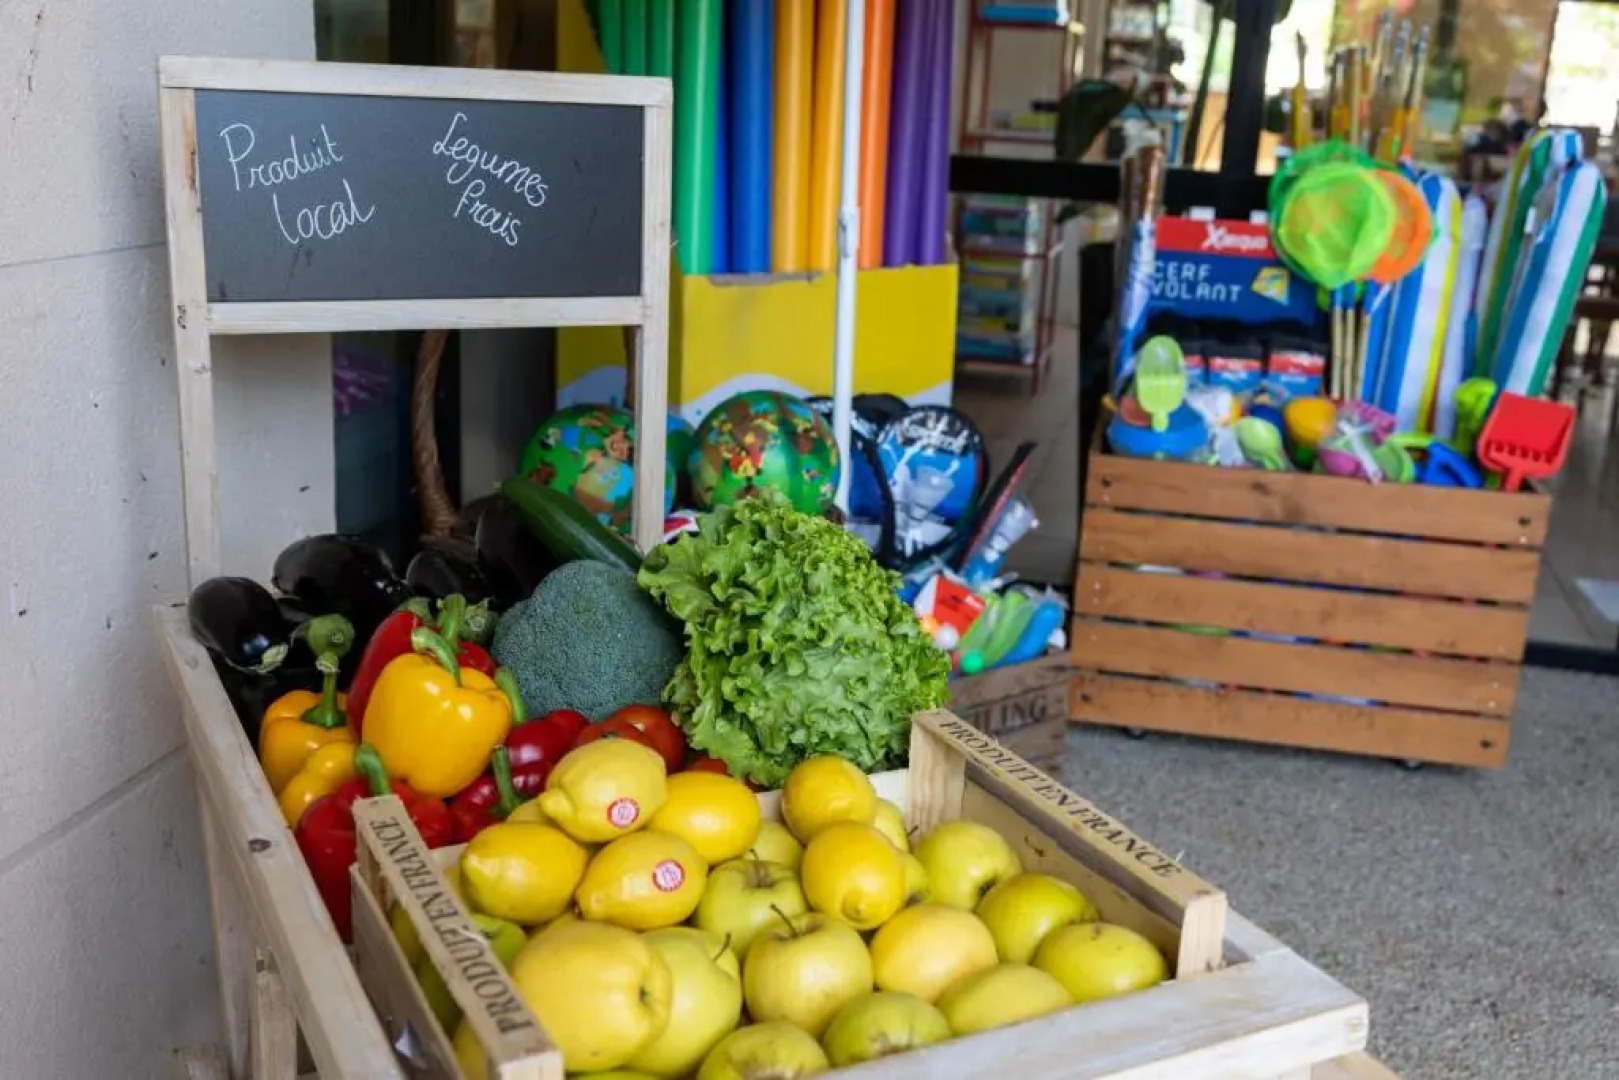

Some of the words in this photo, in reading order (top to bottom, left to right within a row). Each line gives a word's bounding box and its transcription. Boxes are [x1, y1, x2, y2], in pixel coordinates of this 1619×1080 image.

[219, 122, 344, 192] Produit
[432, 111, 549, 207] Legumes
[453, 178, 523, 247] frais
[1151, 279, 1242, 302] VOLANT
[1155, 260, 1211, 281] CERF
[369, 816, 439, 891] FRANCE
[1067, 807, 1182, 878] FRANCE
[433, 923, 534, 1034] PRODUIT
